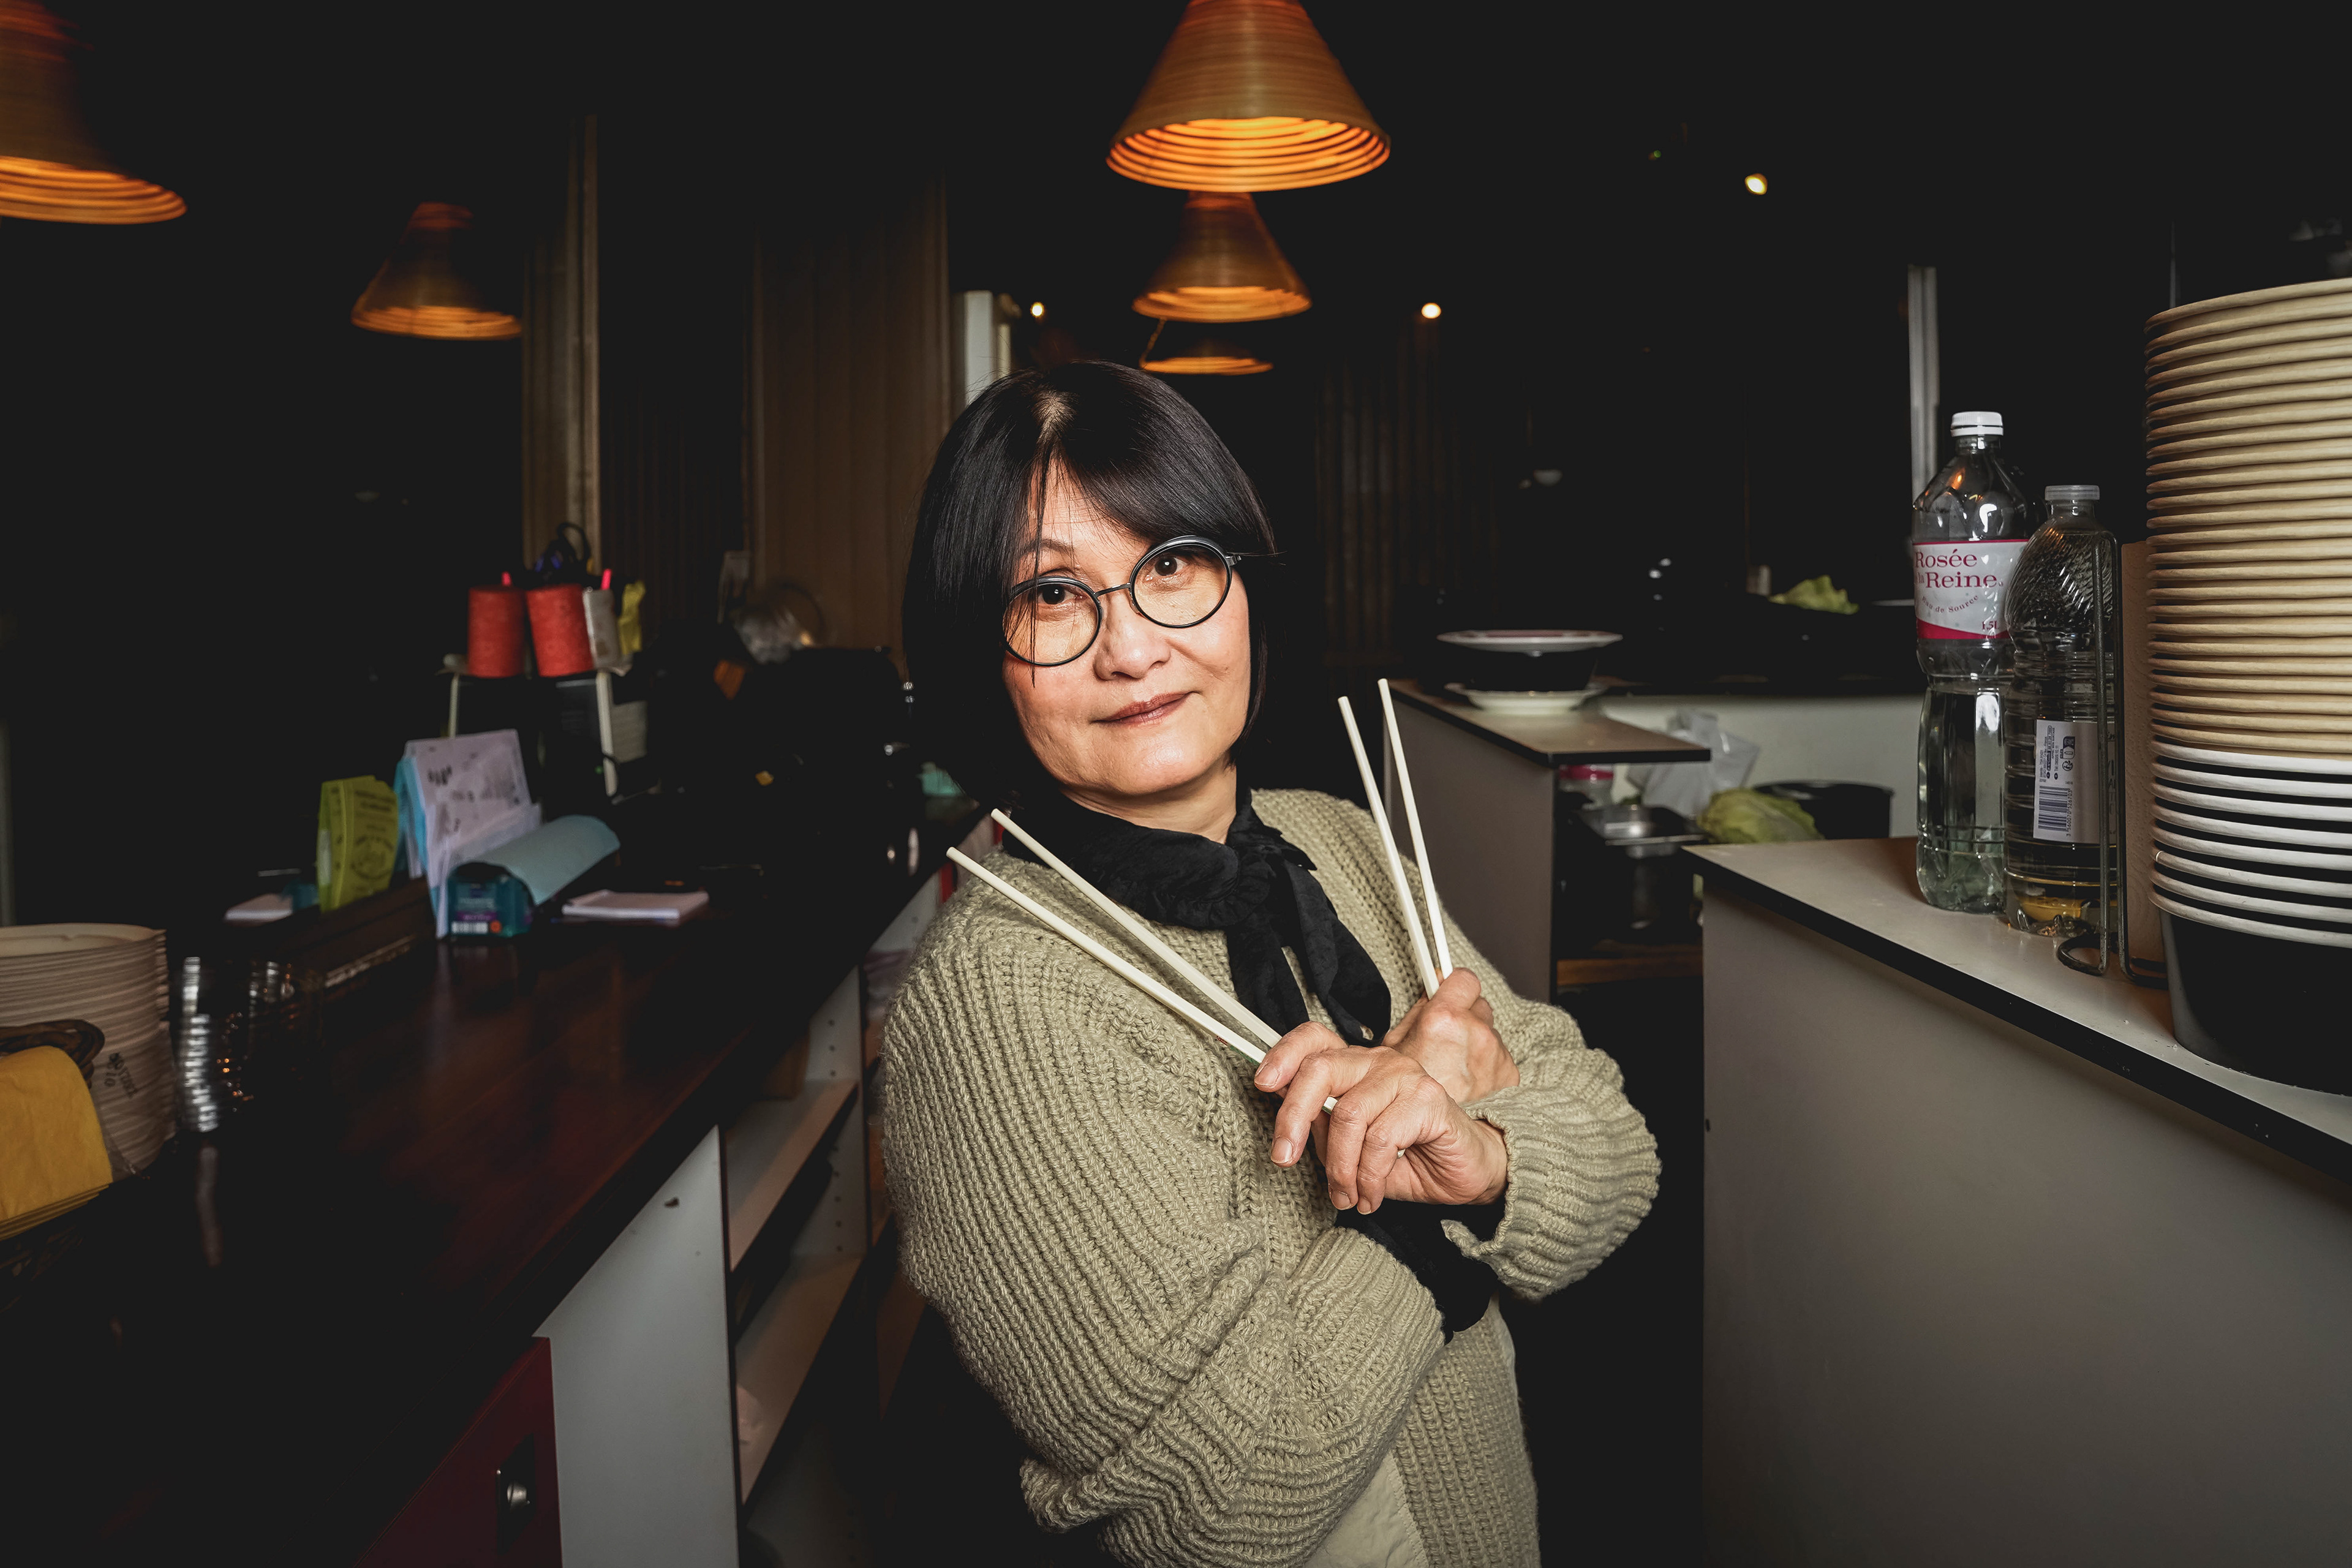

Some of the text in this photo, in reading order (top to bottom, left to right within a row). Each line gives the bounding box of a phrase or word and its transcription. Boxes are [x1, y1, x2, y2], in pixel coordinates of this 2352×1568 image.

[1915, 548, 1977, 568] Rosée
[1925, 571, 1997, 589] Reine
[1921, 595, 1933, 610] Eau
[1948, 595, 1979, 613] Source
